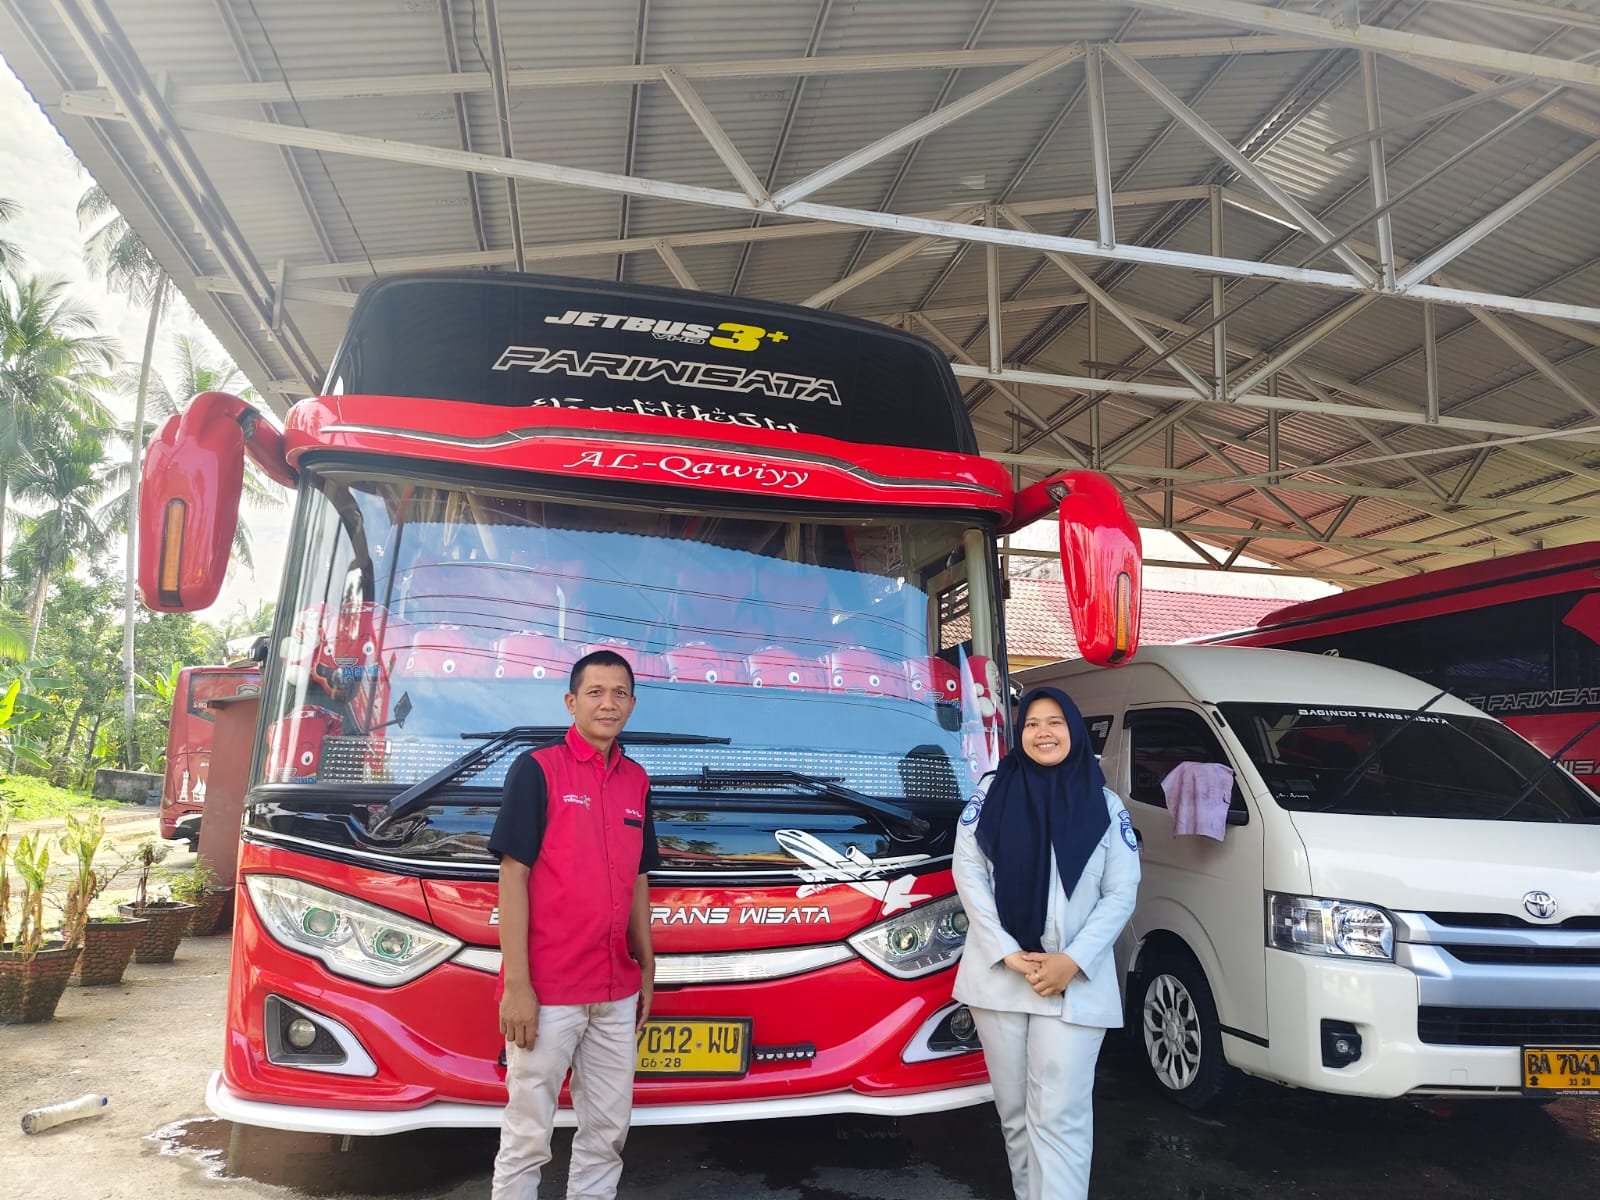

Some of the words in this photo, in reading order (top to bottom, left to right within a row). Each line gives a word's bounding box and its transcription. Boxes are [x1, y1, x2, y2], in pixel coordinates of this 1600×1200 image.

[544, 310, 714, 340] JETBUS
[491, 346, 843, 406] PARIWISATA
[564, 450, 809, 489] AL-Qawiyy
[1358, 711, 1403, 720] TRANS
[739, 906, 832, 925] WISATA
[708, 1026, 740, 1054] WU
[1527, 1053, 1552, 1075] BA
